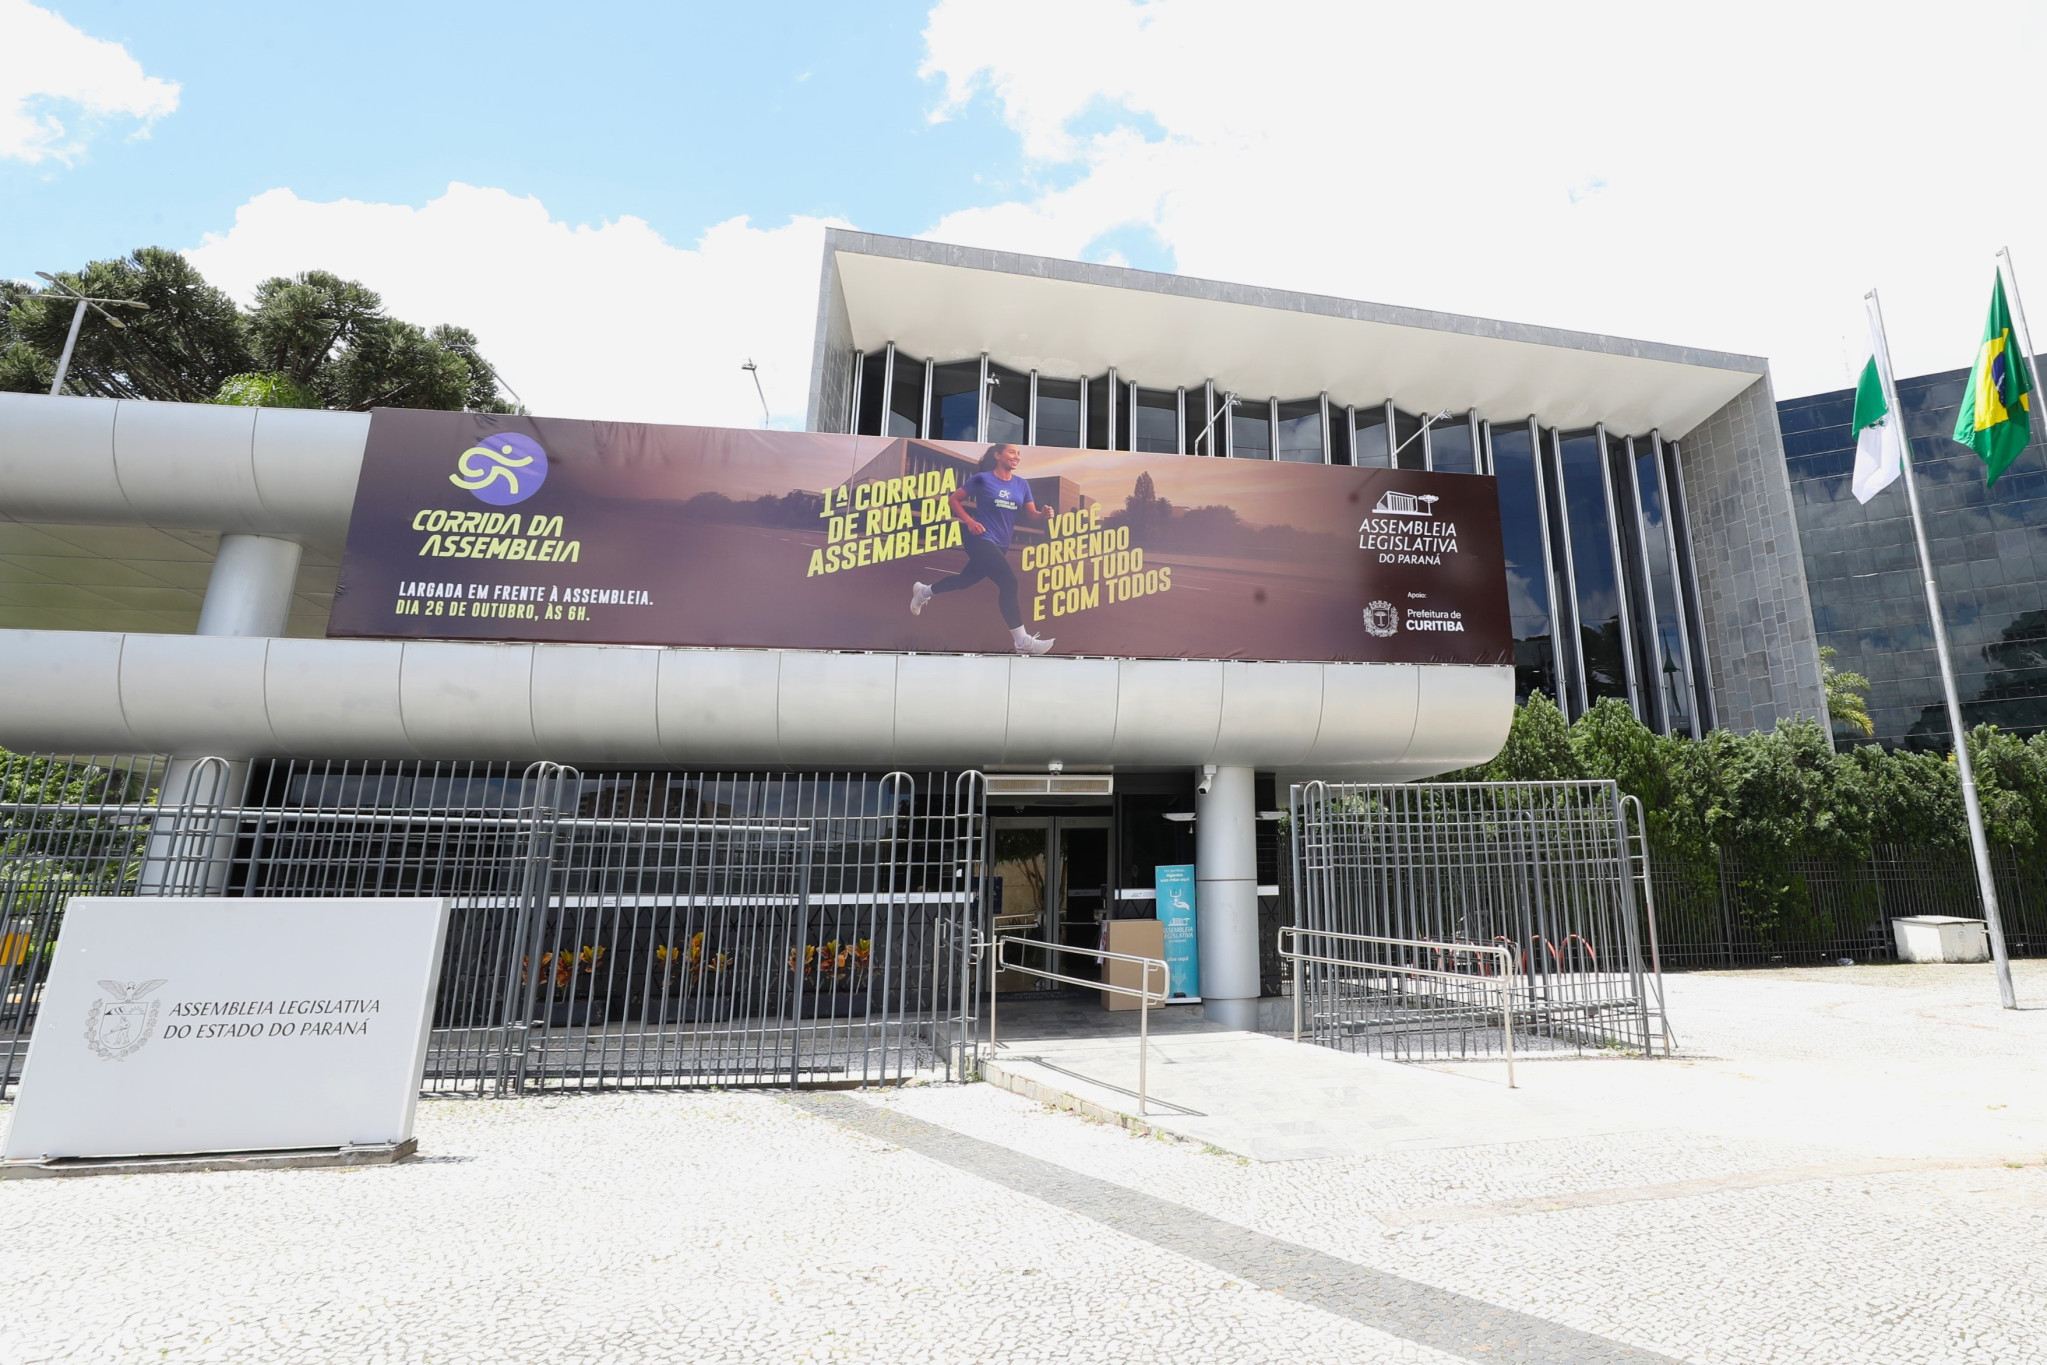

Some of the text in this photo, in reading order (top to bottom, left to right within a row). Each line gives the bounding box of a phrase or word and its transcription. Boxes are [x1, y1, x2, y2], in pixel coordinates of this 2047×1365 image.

[855, 467, 957, 511] CORRIDA
[412, 509, 564, 537] CORRIDA DA
[827, 495, 952, 544] DE RUA DA
[1048, 503, 1102, 540] VOCÊ
[1358, 518, 1457, 537] ASSEMBLEIA
[418, 534, 581, 563] ASSEMBLEIA
[806, 520, 963, 577] ASSEMBLEIA
[1021, 526, 1130, 572] CORRENDO
[1358, 534, 1458, 553] LEGISLATIVA
[1037, 547, 1143, 594] COM TUDO
[1379, 553, 1441, 565] DO PARANÁ
[398, 581, 655, 606] LARGADA EM FRENTE À ASSEMBLEIA.
[1033, 567, 1172, 621] E COM TODOS
[395, 599, 591, 622] DIA 26 DE OUTUBRO, ÀS 6H.
[1407, 608, 1462, 619] Prefeitura de
[1406, 620, 1465, 632] CURITIBA
[169, 999, 381, 1017] ASSEMBLEIA LEGISLATIVA
[163, 1018, 370, 1039] DO ESTADO DO PARANÁ
